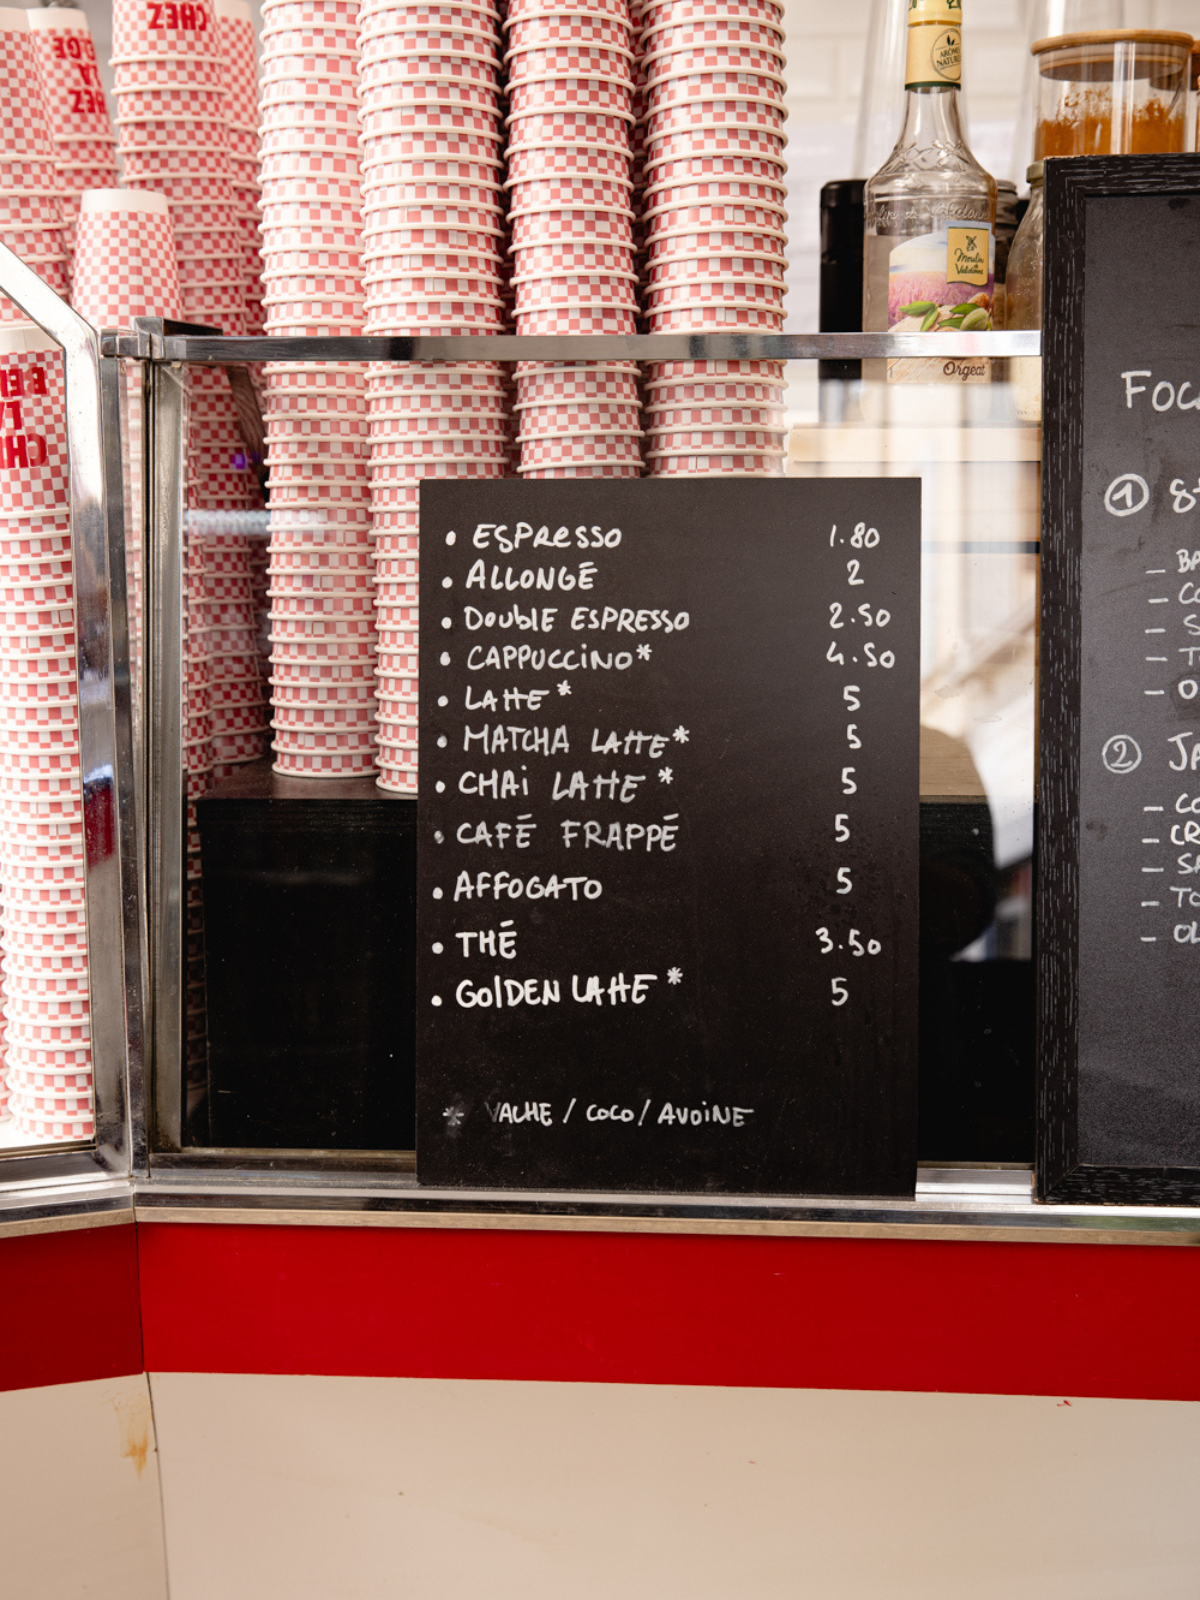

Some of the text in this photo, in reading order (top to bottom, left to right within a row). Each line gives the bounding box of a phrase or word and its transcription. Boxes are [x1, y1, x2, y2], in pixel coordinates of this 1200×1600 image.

[146, 2, 208, 32] CHEZ
[942, 360, 986, 381] Orgeat
[829, 521, 881, 549] 1.80
[465, 558, 599, 592] ALLONGÉ
[846, 558, 865, 586] 2
[570, 605, 690, 634] ESPRESSO
[829, 601, 891, 629] 2.50
[826, 640, 896, 669] 4.50
[843, 684, 861, 712] 5
[463, 723, 570, 757] MATCHA
[846, 723, 862, 750] 5
[841, 766, 858, 795] 5
[456, 813, 679, 852] CAFÉ FRAPPÉ
[834, 813, 850, 843] 5
[453, 870, 603, 902] AFFOGATO
[836, 867, 853, 895] 5
[455, 919, 517, 960] THÉ
[815, 926, 882, 957] 3.50
[831, 977, 849, 1006] 5
